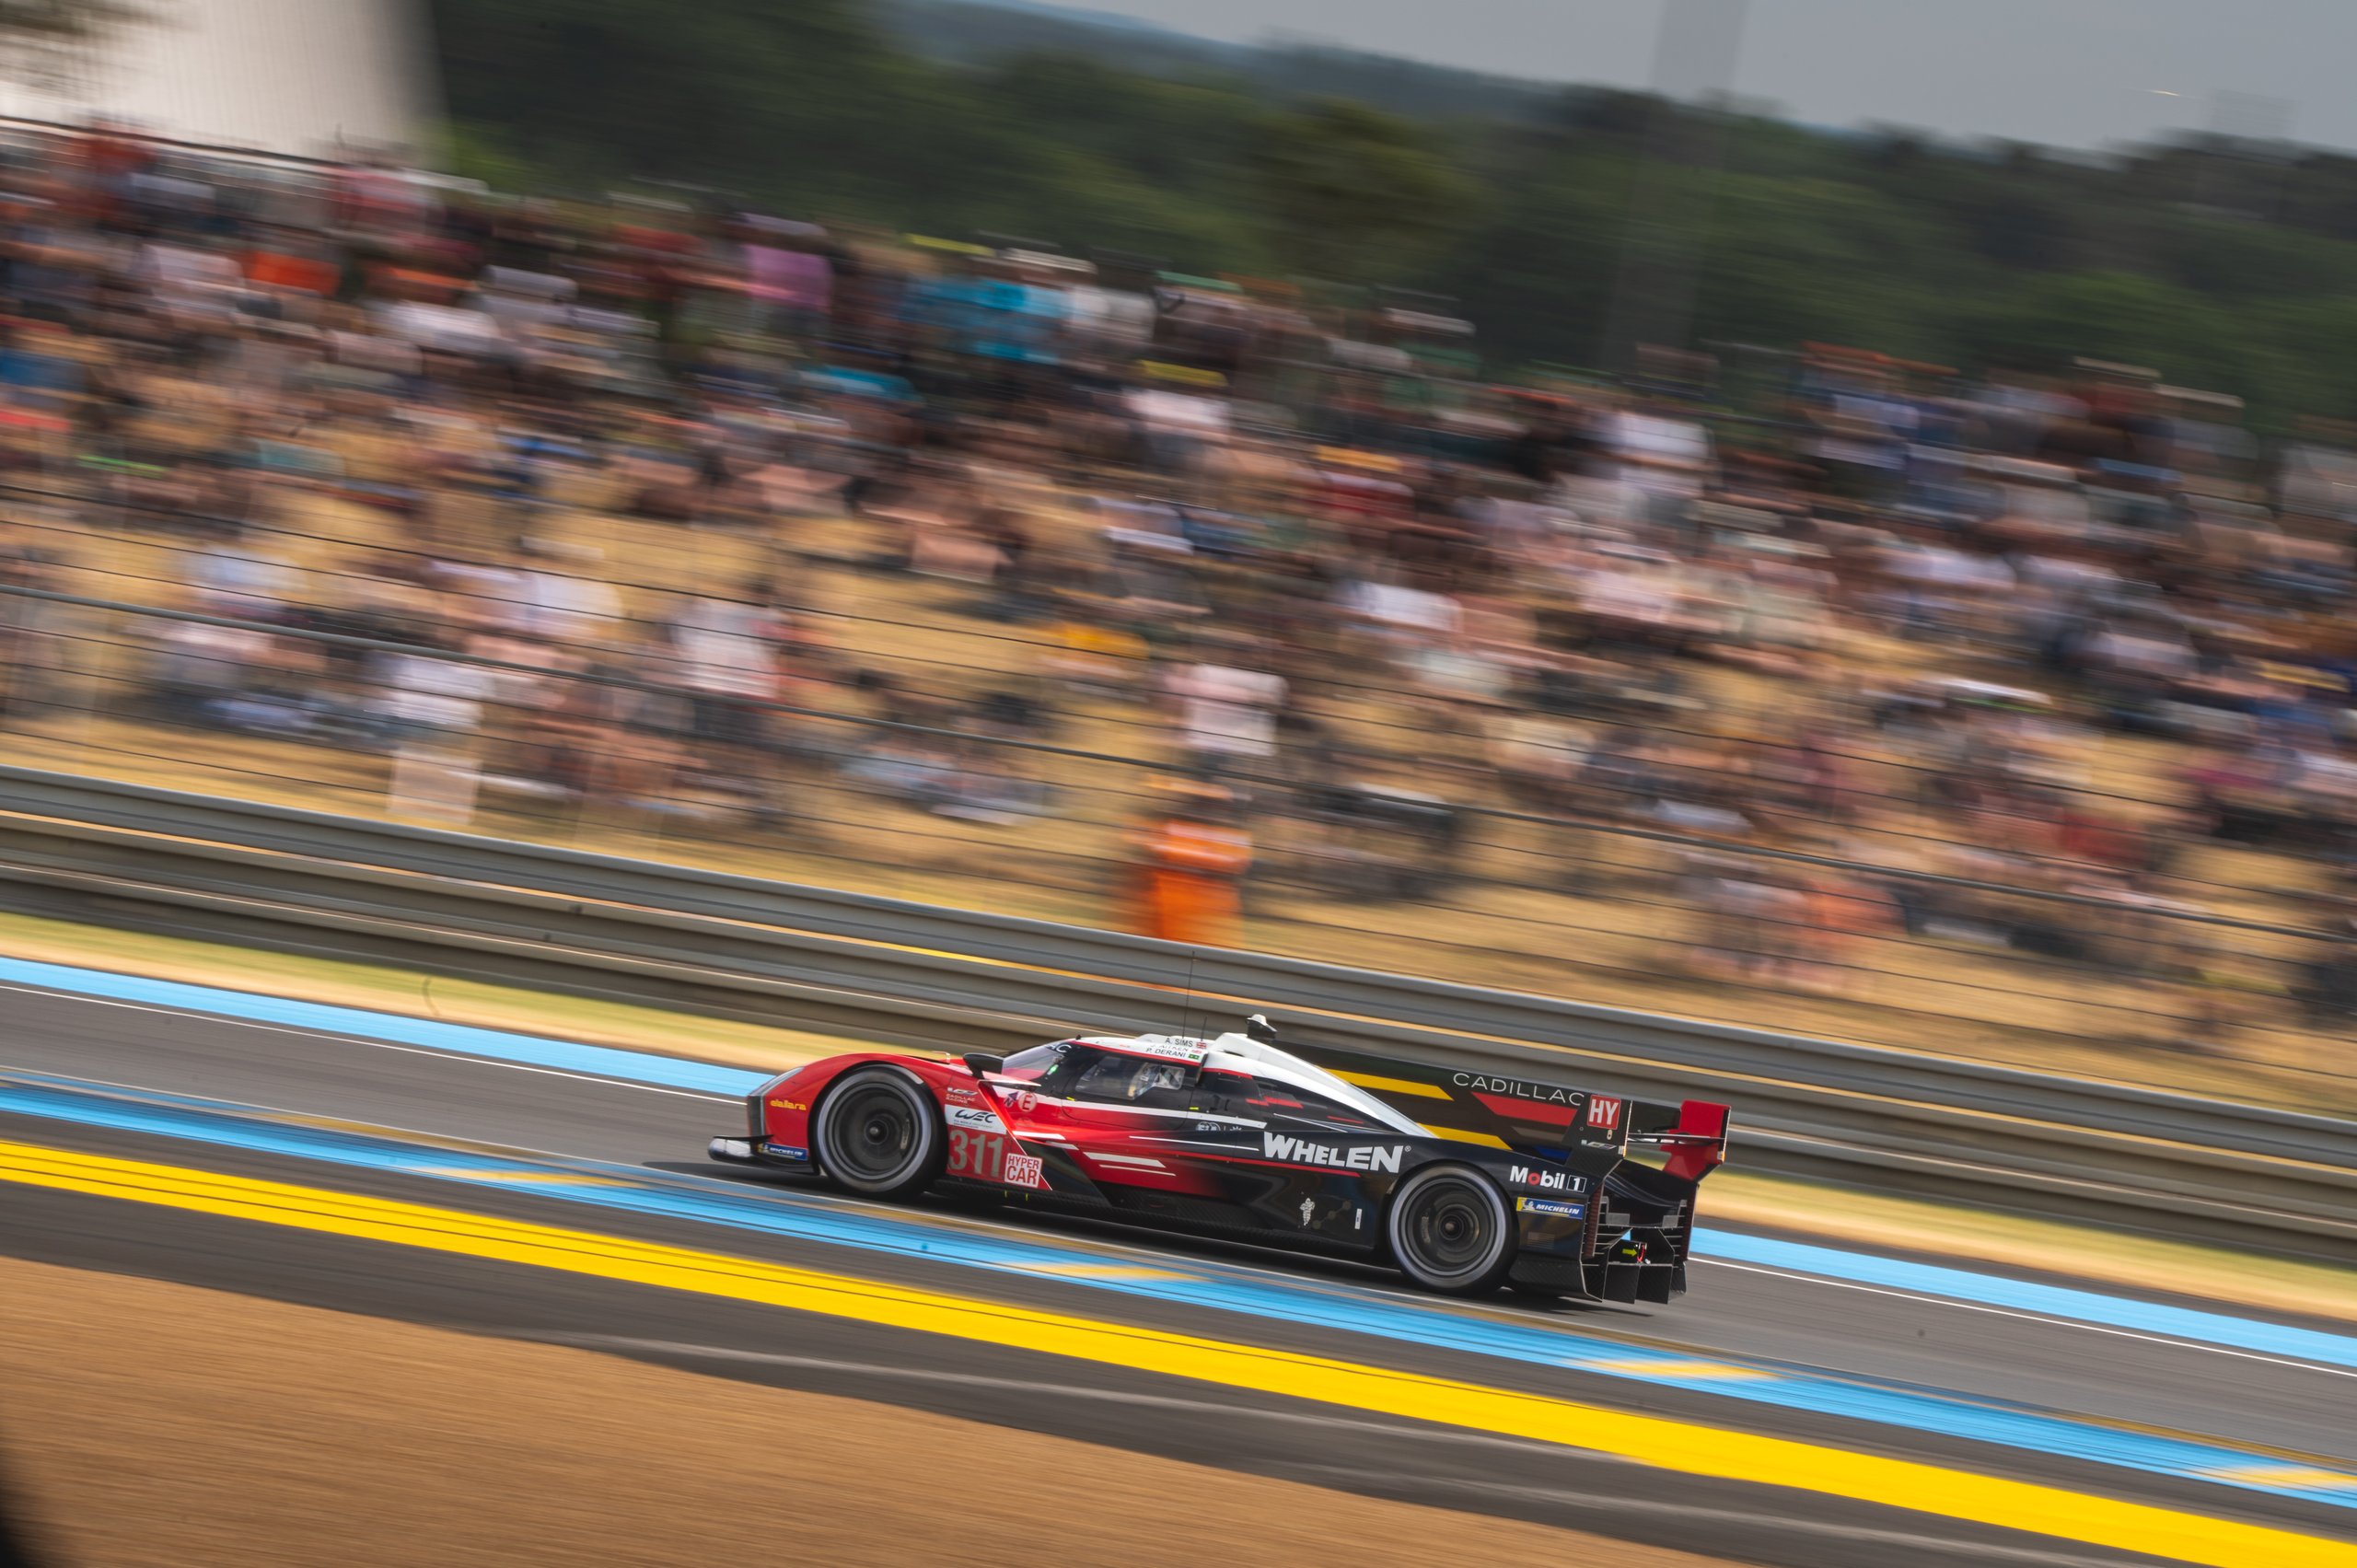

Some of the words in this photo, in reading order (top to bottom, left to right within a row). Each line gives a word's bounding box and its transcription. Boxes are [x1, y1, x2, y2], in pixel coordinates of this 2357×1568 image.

[1175, 1039, 1193, 1048] SIMS
[1155, 1048, 1186, 1058] DERANI
[1453, 1073, 1585, 1106] CADILLAC
[1022, 1094, 1033, 1110] E
[955, 1109, 997, 1123] WEC
[1589, 1098, 1620, 1125] HY
[948, 1130, 1004, 1178] 311
[1008, 1156, 1039, 1169] HYPER
[1006, 1166, 1038, 1185] CAR
[1510, 1166, 1565, 1190] Mobil
[1536, 1203, 1580, 1214] MICHELIN
